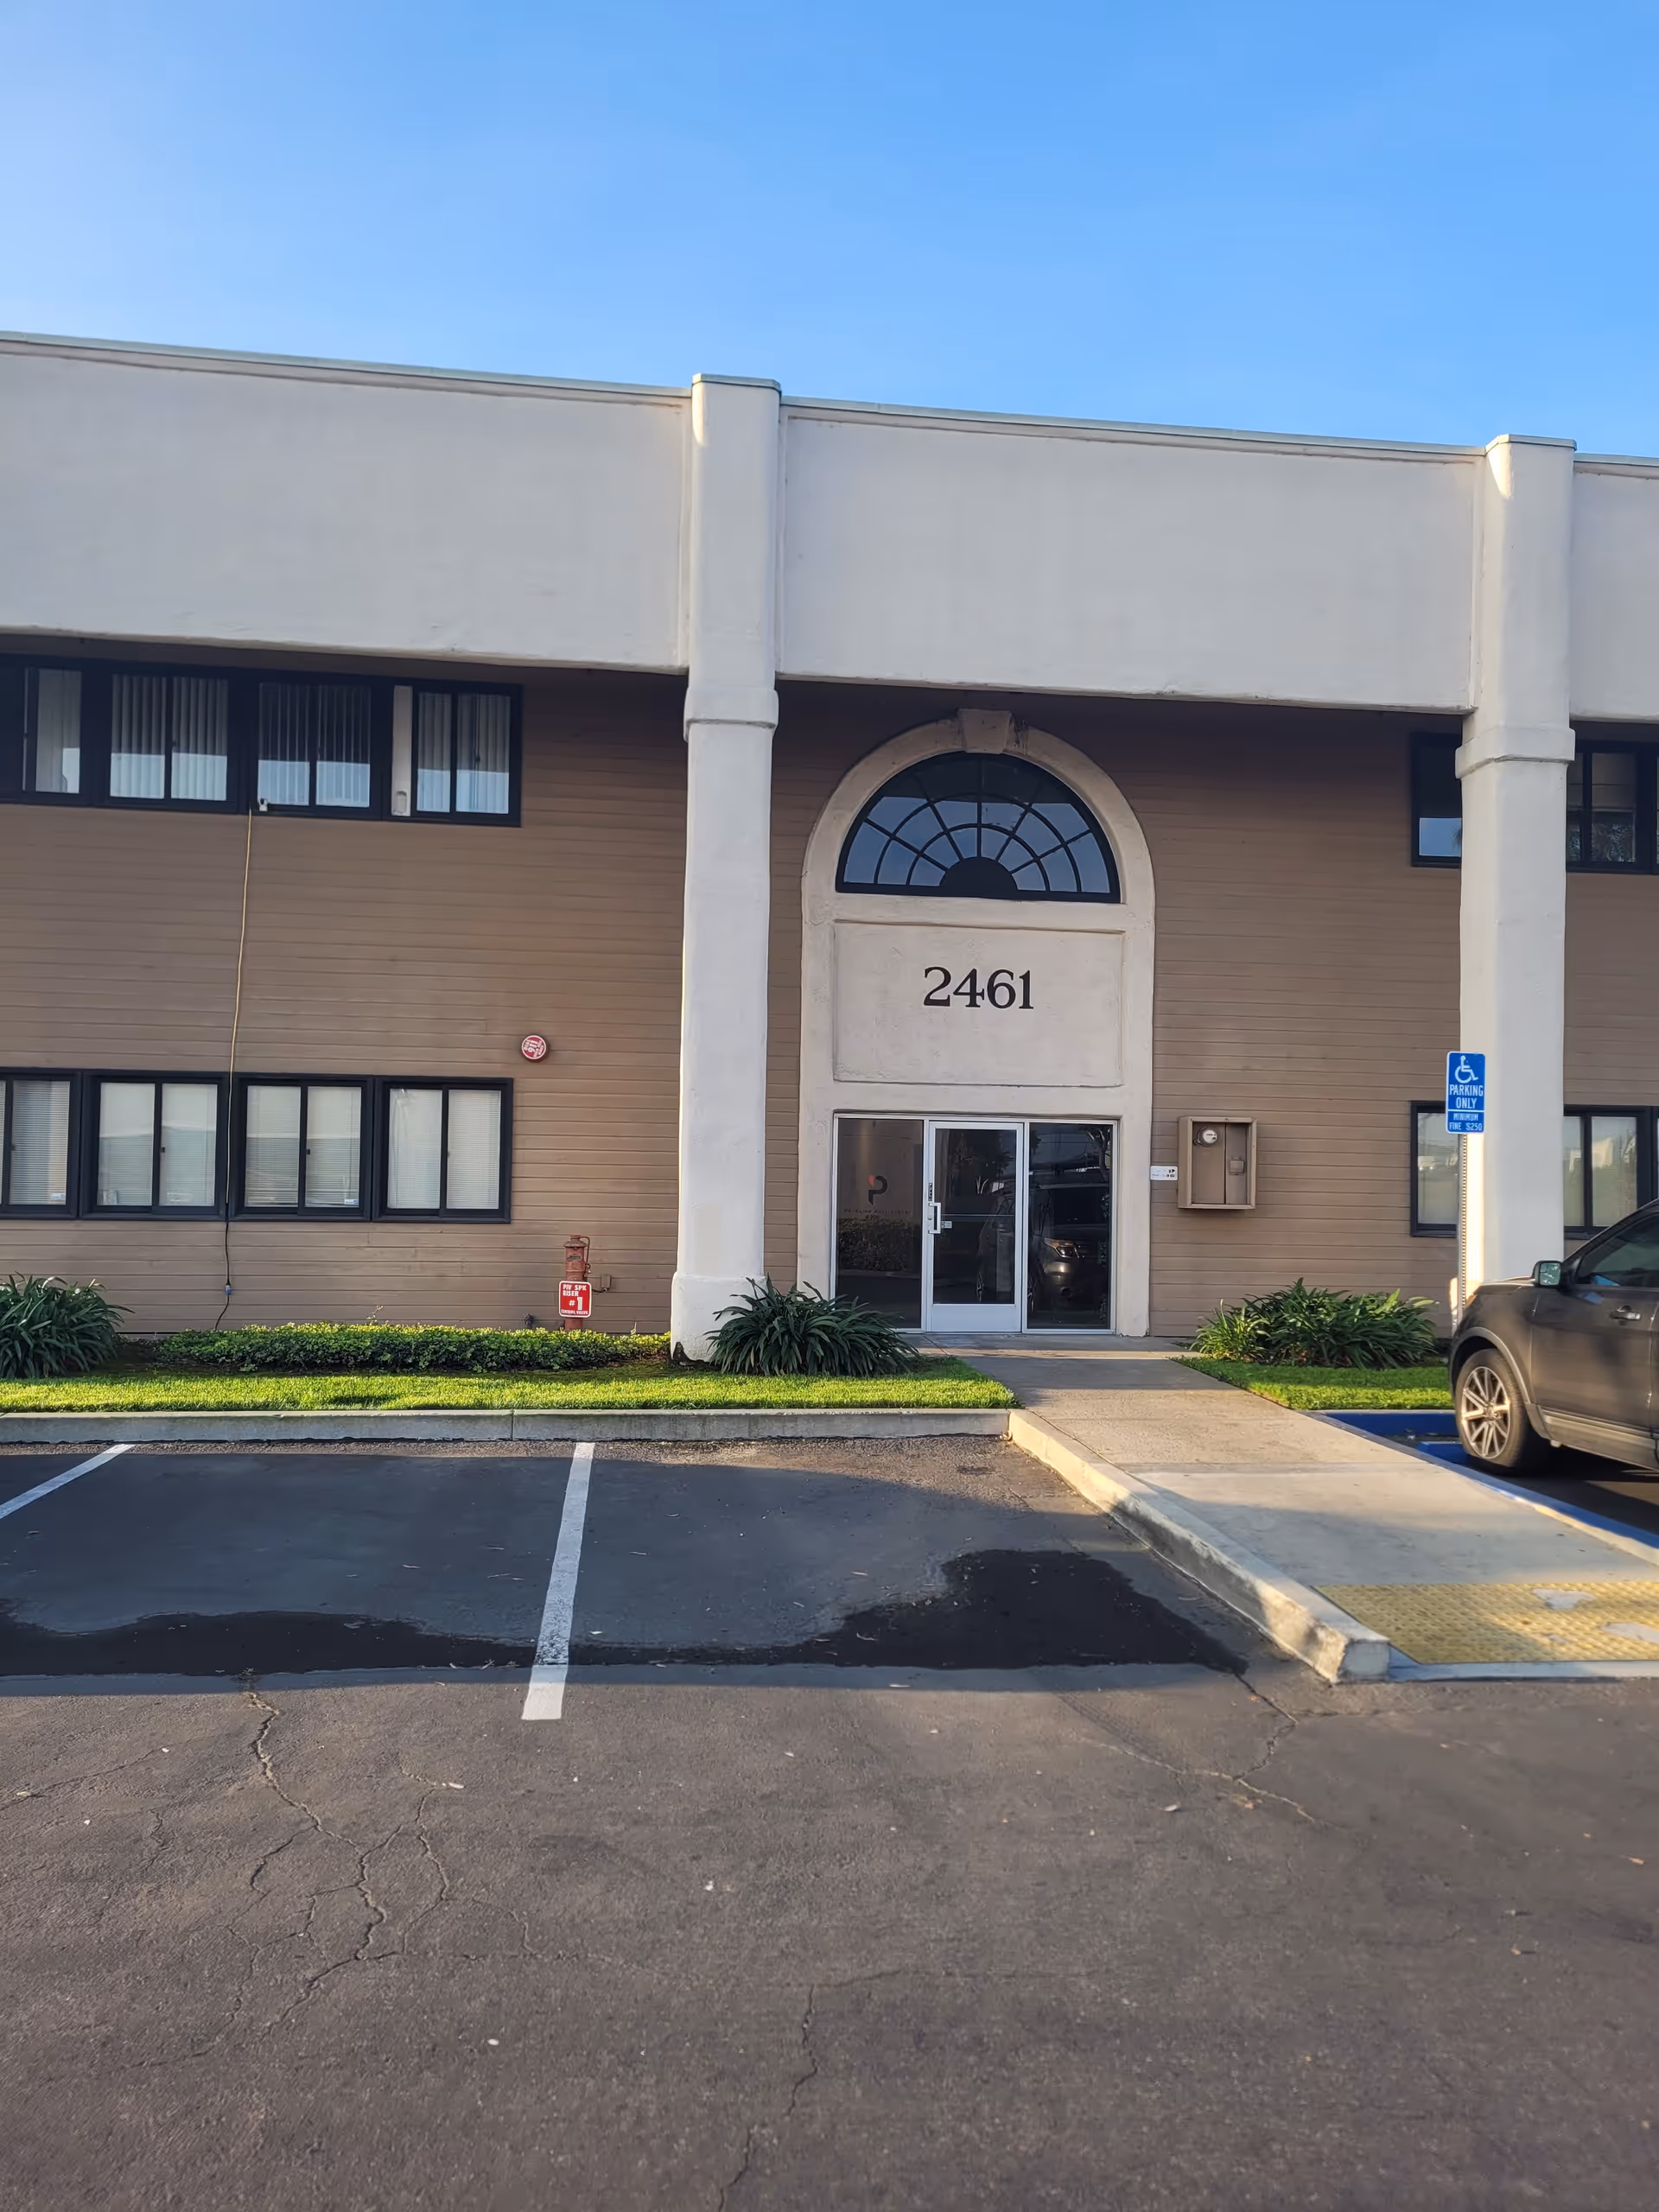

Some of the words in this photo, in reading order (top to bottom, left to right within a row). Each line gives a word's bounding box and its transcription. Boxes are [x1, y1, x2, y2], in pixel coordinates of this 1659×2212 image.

[923, 966, 1034, 1009] 2461
[1449, 1084, 1484, 1096] PARKING
[1456, 1096, 1478, 1109] ONLY
[1449, 1122, 1462, 1130] FINE
[1465, 1122, 1483, 1131] $250
